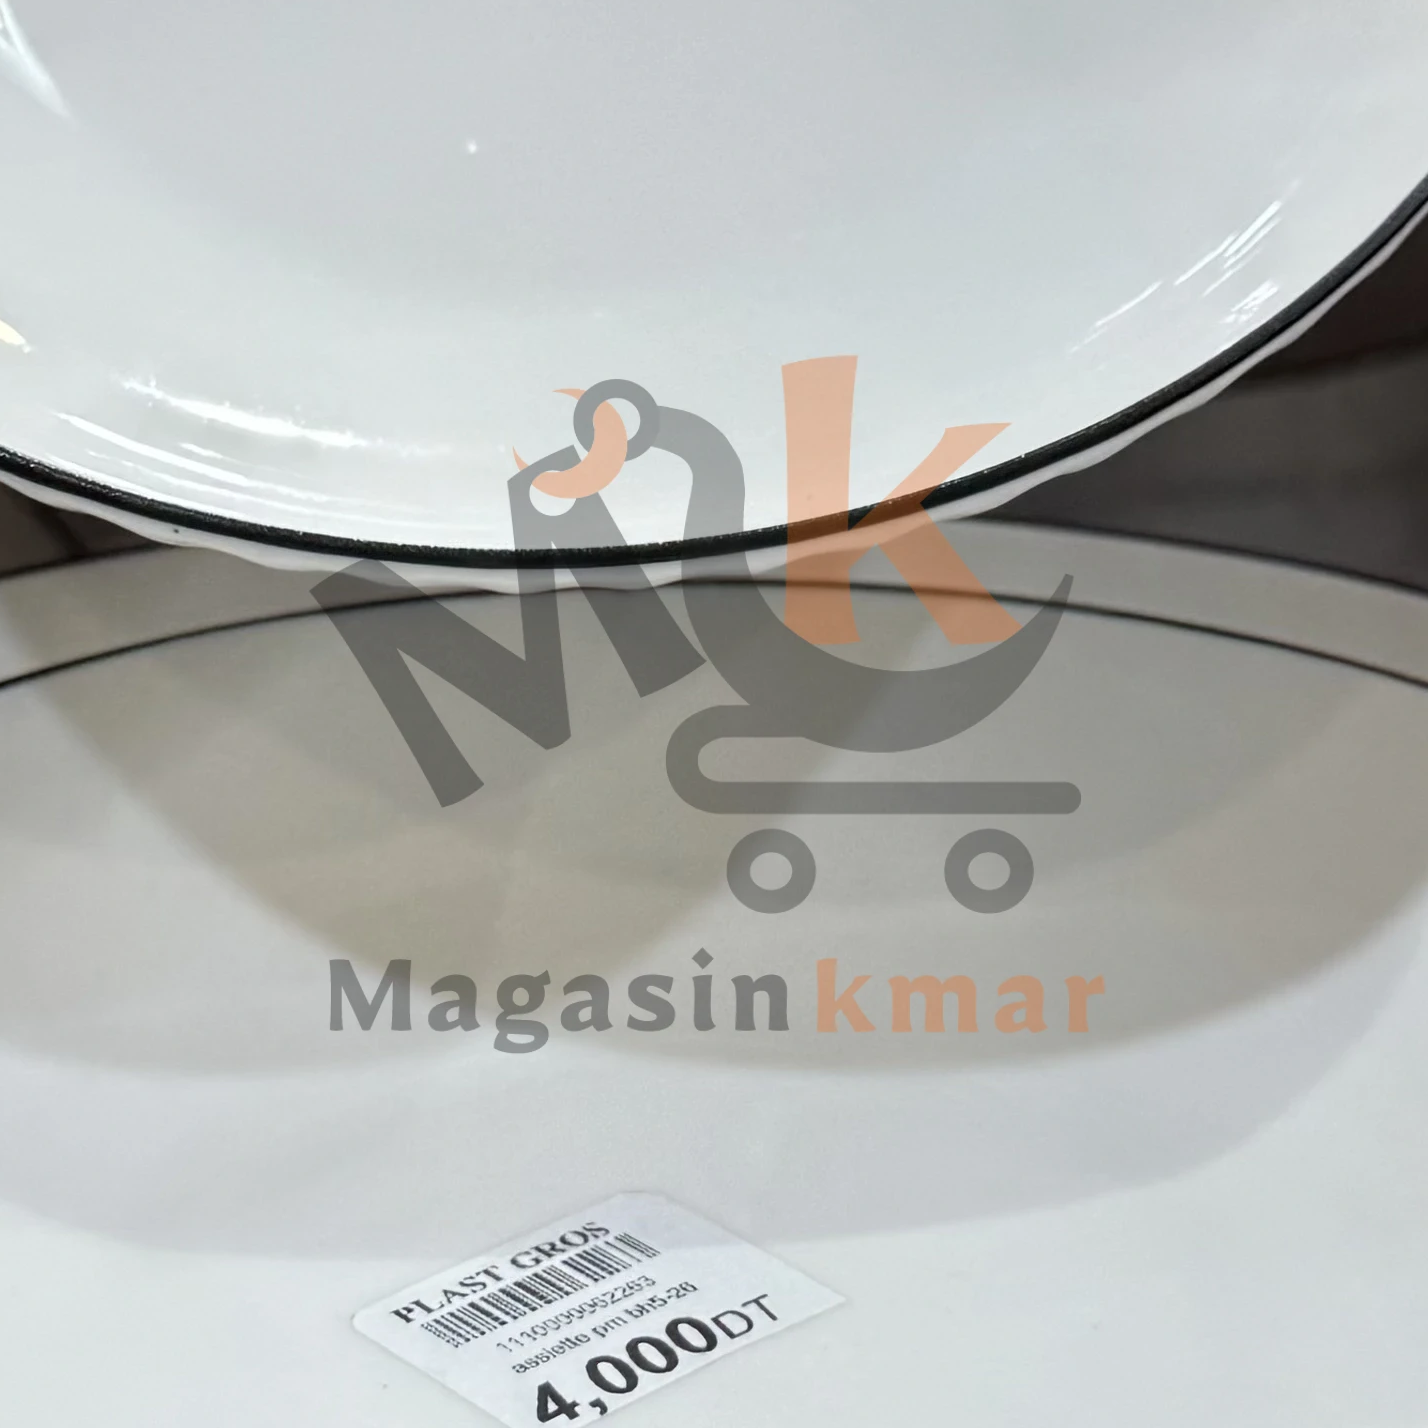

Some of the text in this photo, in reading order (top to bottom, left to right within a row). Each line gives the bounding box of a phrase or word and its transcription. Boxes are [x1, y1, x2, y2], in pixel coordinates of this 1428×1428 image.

[389, 1222, 611, 1323] PLAST GROS
[512, 1332, 591, 1374] assiette
[591, 1316, 629, 1340] pm
[536, 1293, 778, 1424] 4,000DT
